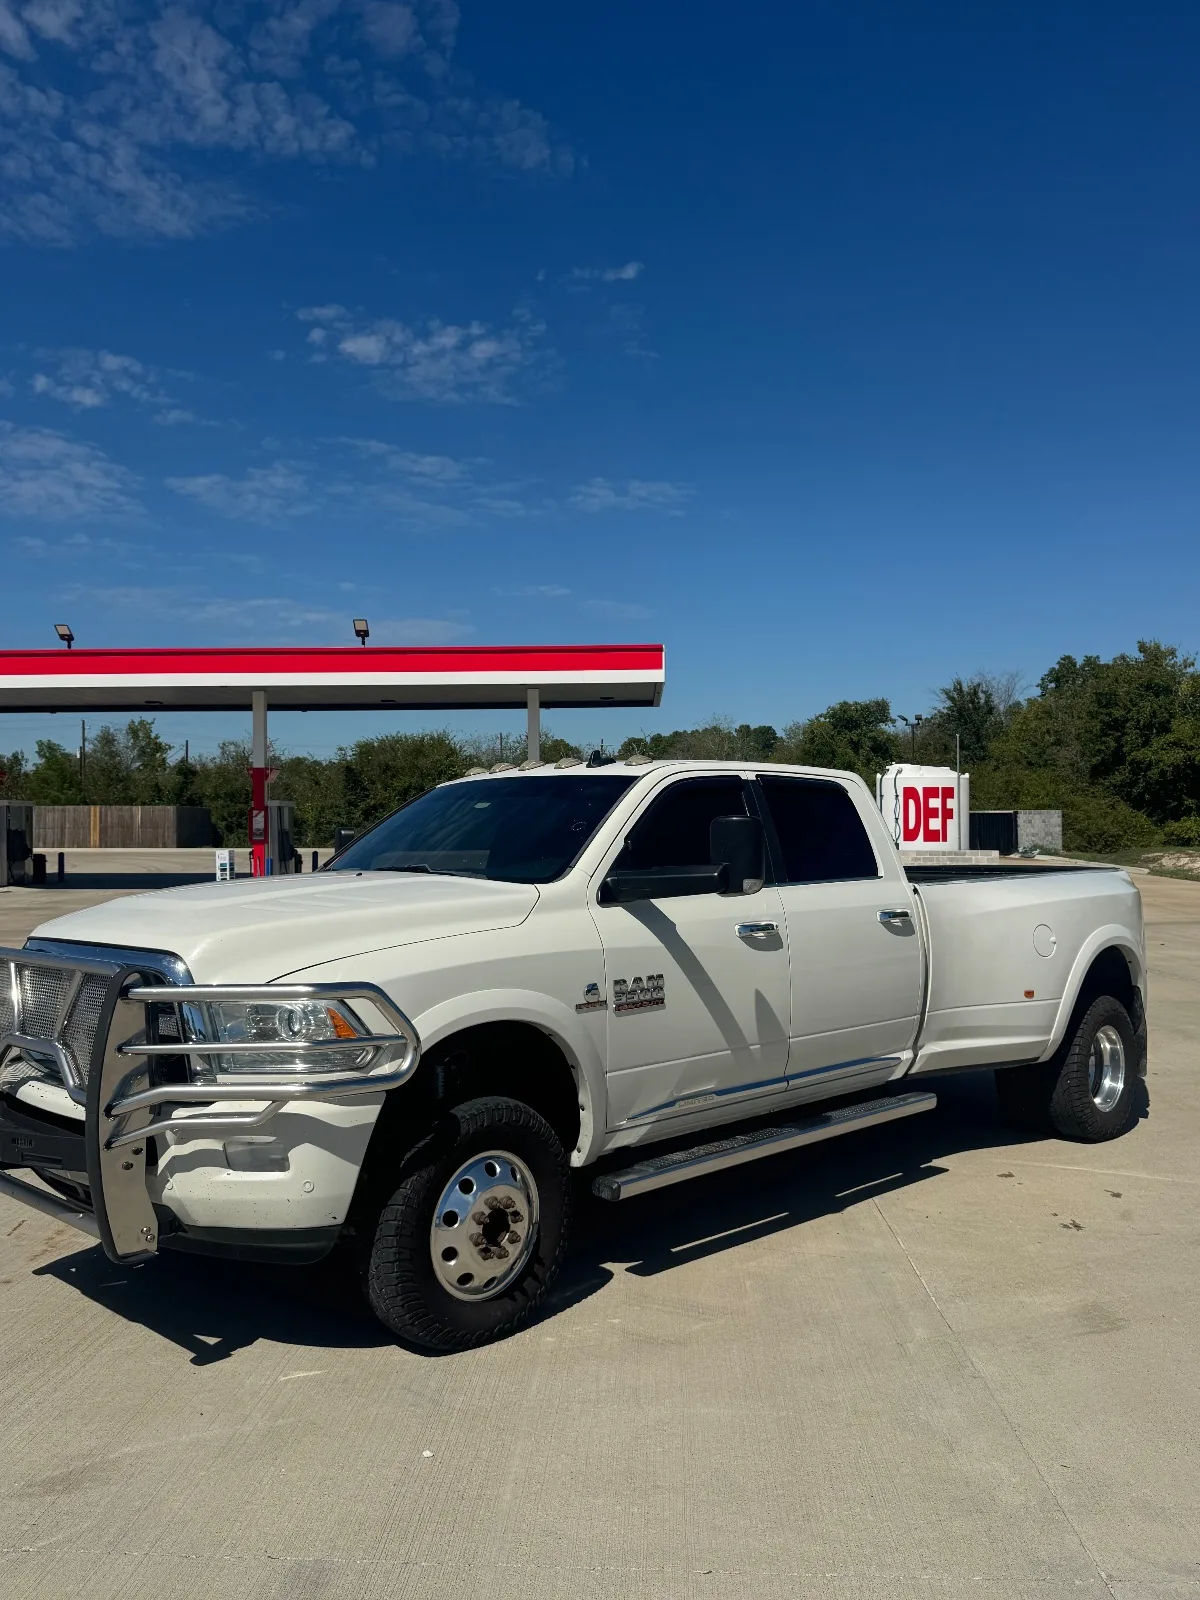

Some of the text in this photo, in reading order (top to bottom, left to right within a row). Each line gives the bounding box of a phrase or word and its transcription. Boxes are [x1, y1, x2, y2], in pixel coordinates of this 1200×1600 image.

[903, 787, 954, 842] DEF
[613, 974, 664, 993] RAM
[614, 987, 665, 1005] 3500
